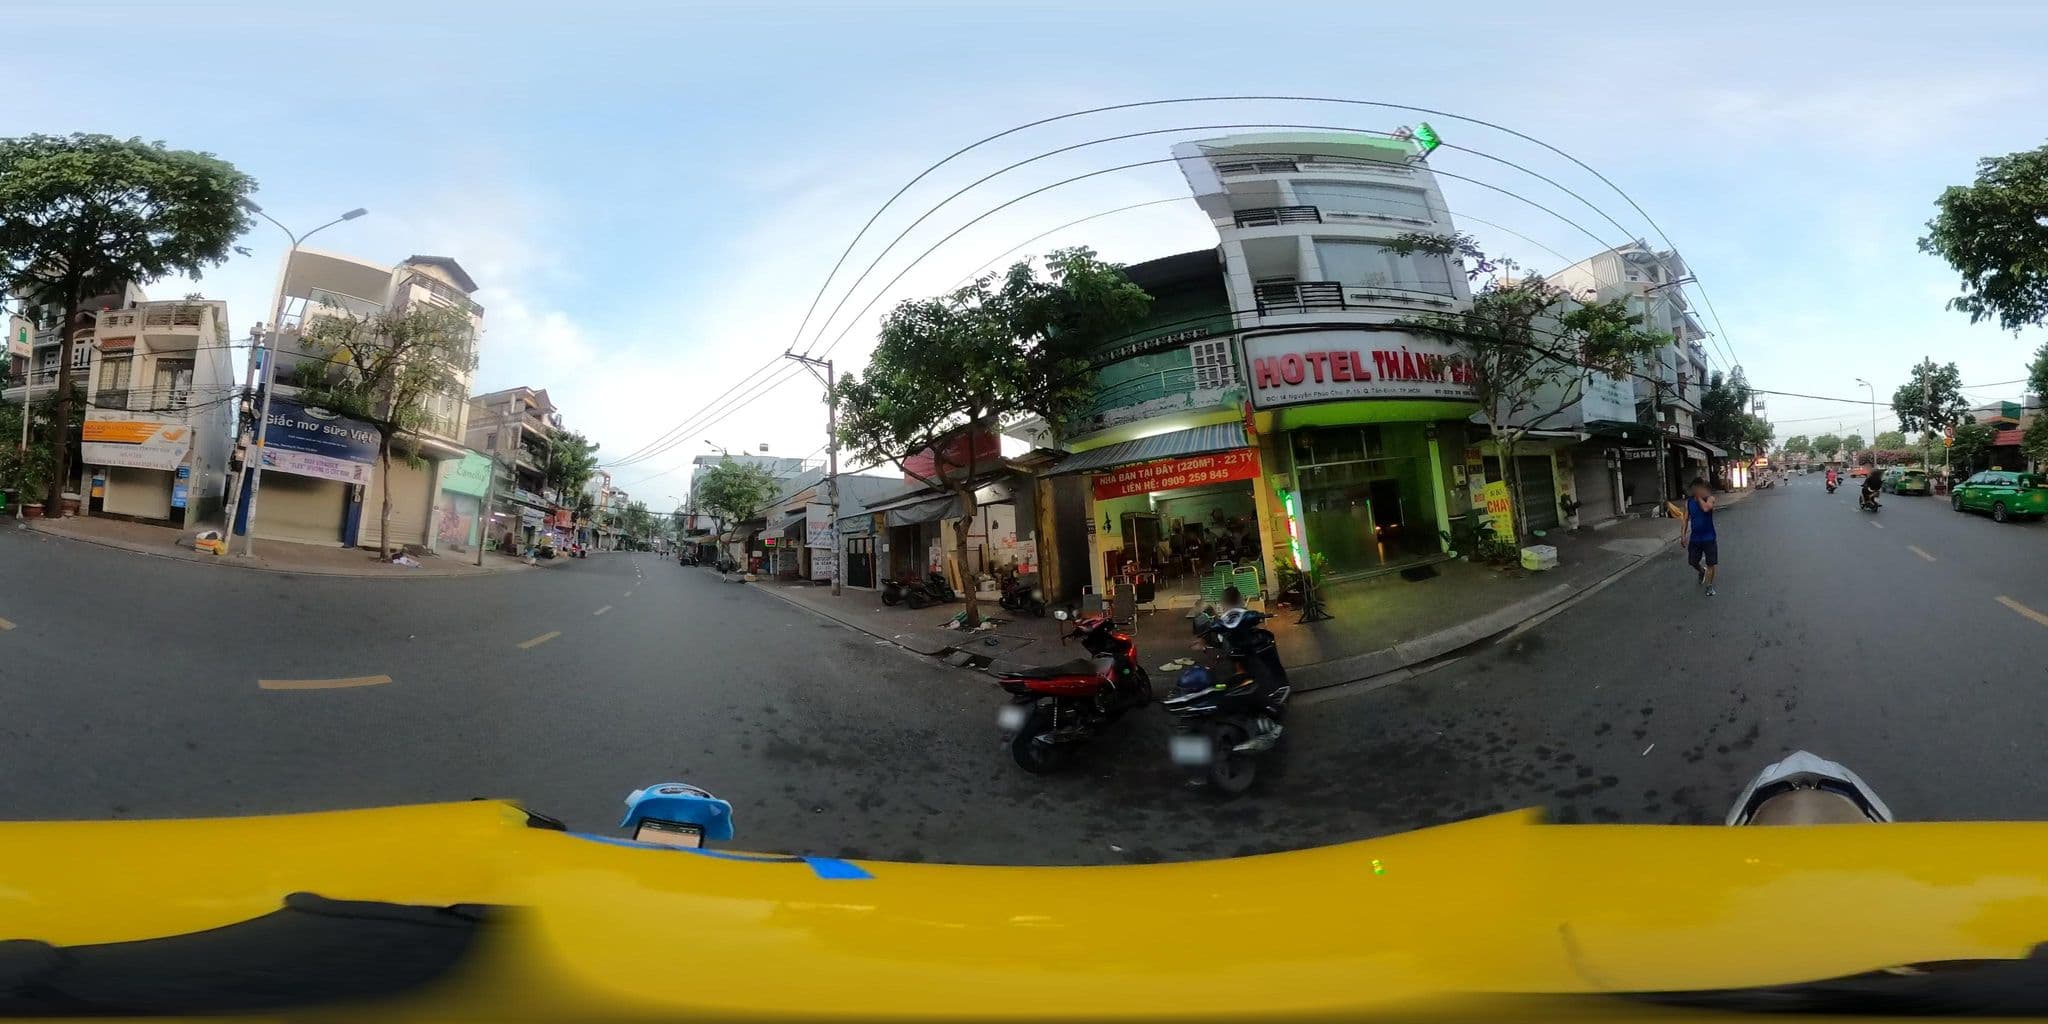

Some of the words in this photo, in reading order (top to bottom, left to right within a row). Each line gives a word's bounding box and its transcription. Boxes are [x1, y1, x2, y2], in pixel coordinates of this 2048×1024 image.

[1254, 350, 1372, 390] HOTEL
[296, 421, 320, 432] mơ
[322, 425, 348, 437] sữa
[350, 427, 373, 444] Việt
[1139, 468, 1154, 480] TẠI
[1155, 463, 1175, 476] ĐÂY
[1224, 454, 1238, 465] 22
[1121, 481, 1142, 494] LIÊN
[1161, 474, 1186, 487] 0909
[1188, 471, 1208, 483] 259
[1209, 468, 1230, 480] 845
